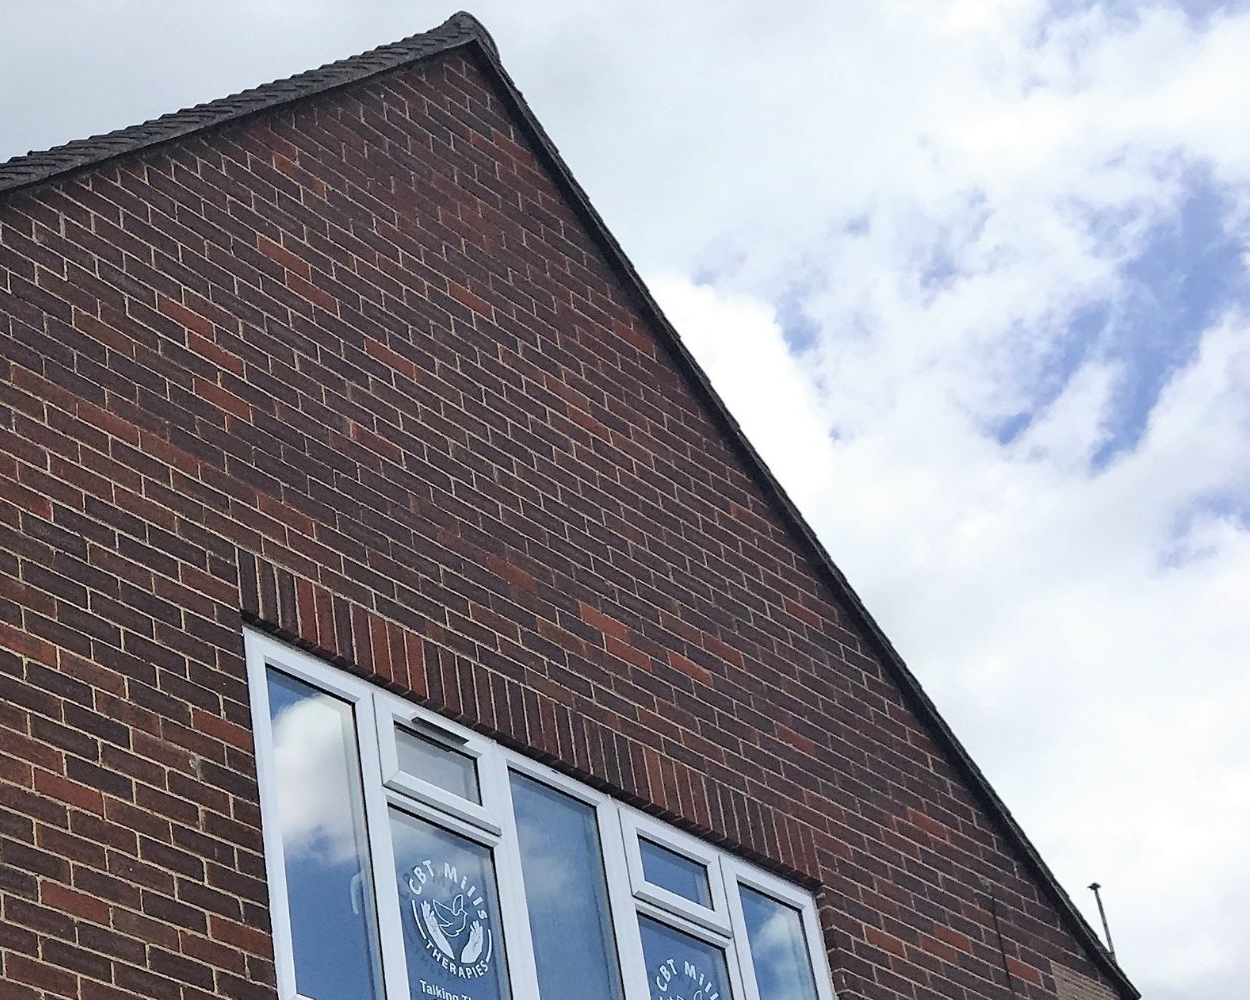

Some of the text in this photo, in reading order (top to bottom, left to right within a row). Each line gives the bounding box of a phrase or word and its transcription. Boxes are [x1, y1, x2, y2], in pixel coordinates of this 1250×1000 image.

[408, 859, 488, 920] CBT Mills
[425, 939, 489, 980] THERAPIES
[656, 958, 678, 992] CBT
